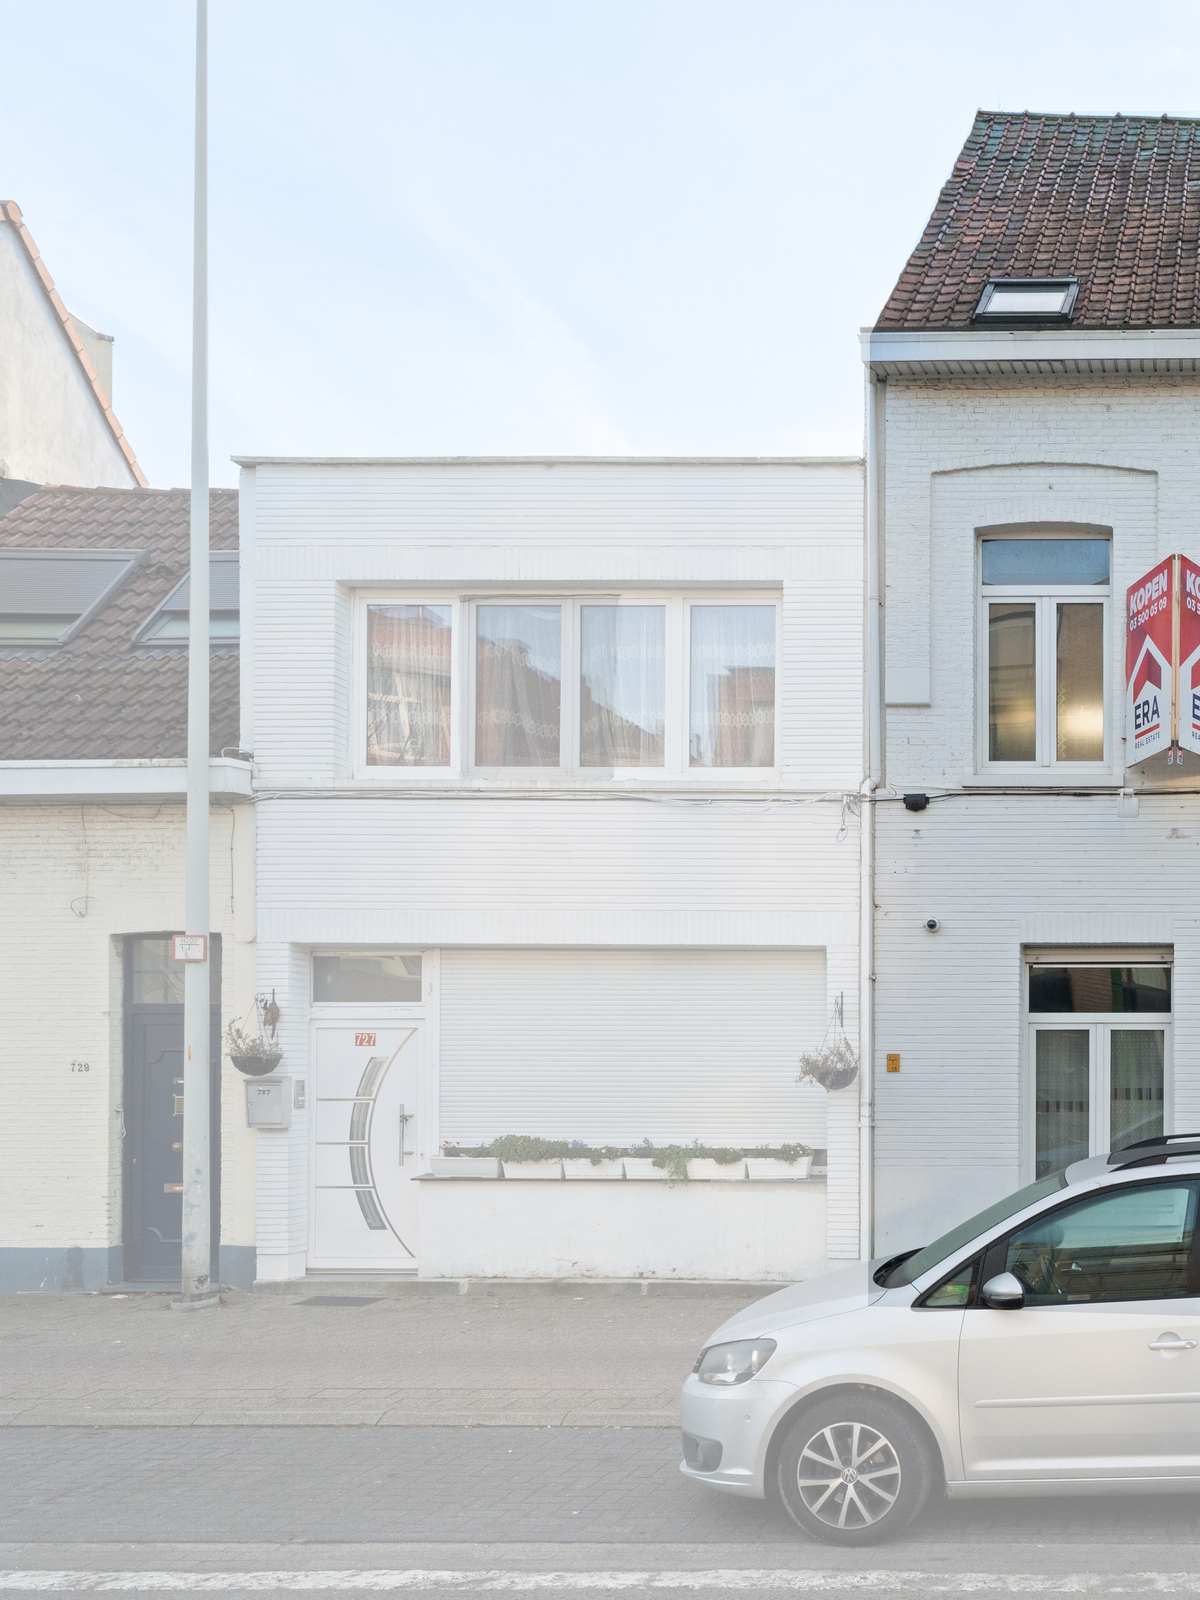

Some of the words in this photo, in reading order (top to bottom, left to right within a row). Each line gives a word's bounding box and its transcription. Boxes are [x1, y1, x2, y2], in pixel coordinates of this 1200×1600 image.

[1130, 569, 1167, 617] KOPEN
[1130, 618, 1137, 631] 03
[1138, 609, 1149, 626] 500
[1150, 602, 1158, 617] 05
[1159, 596, 1167, 611] 09
[1186, 597, 1196, 611] 03
[1134, 695, 1160, 730] ERA
[1135, 739, 1145, 750] REAL
[1145, 731, 1160, 745] ESTATE
[355, 1033, 375, 1046] 727
[70, 1062, 90, 1072] 729
